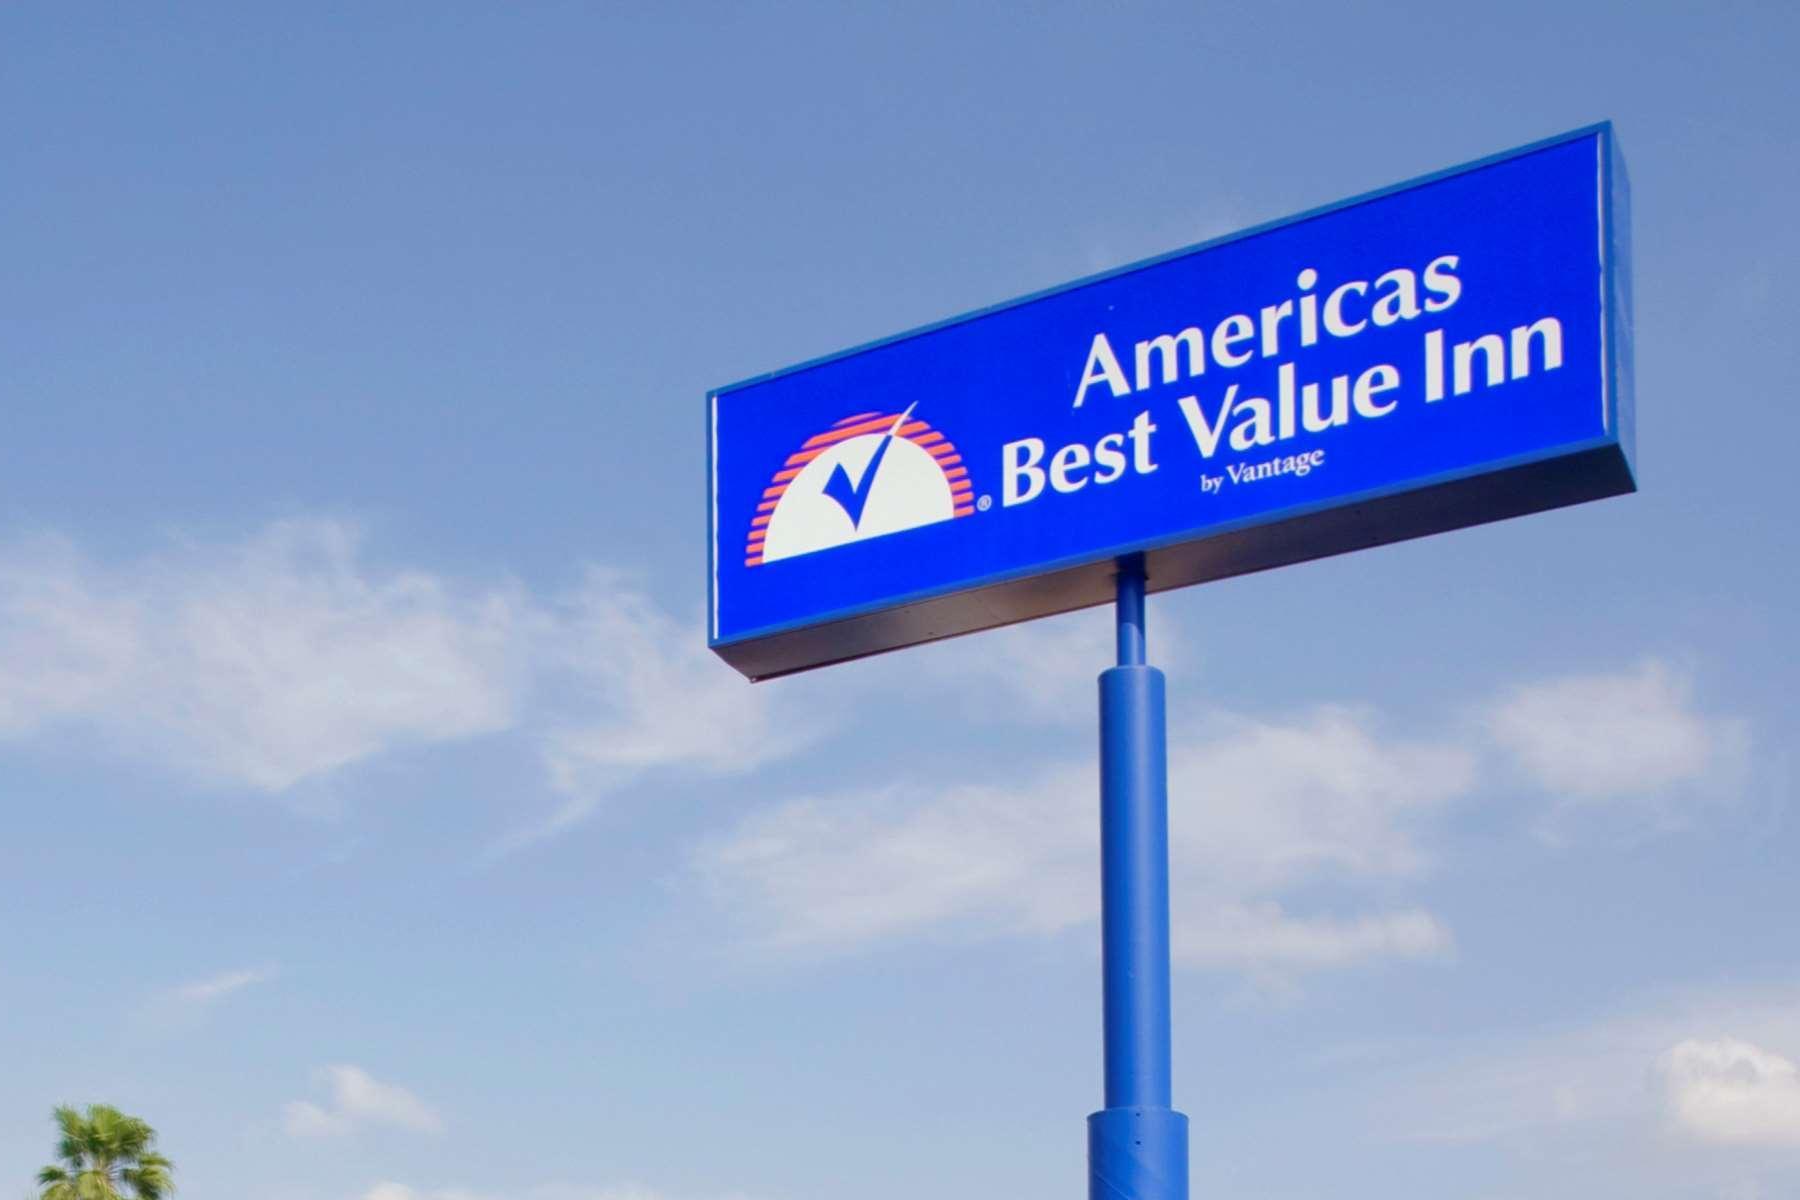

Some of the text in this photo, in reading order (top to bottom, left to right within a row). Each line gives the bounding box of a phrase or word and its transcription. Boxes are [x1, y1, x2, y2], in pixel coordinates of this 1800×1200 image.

[1073, 255, 1462, 408] Americas
[1002, 317, 1563, 507] Best Value Inn
[1200, 449, 1325, 494] by Vantage
